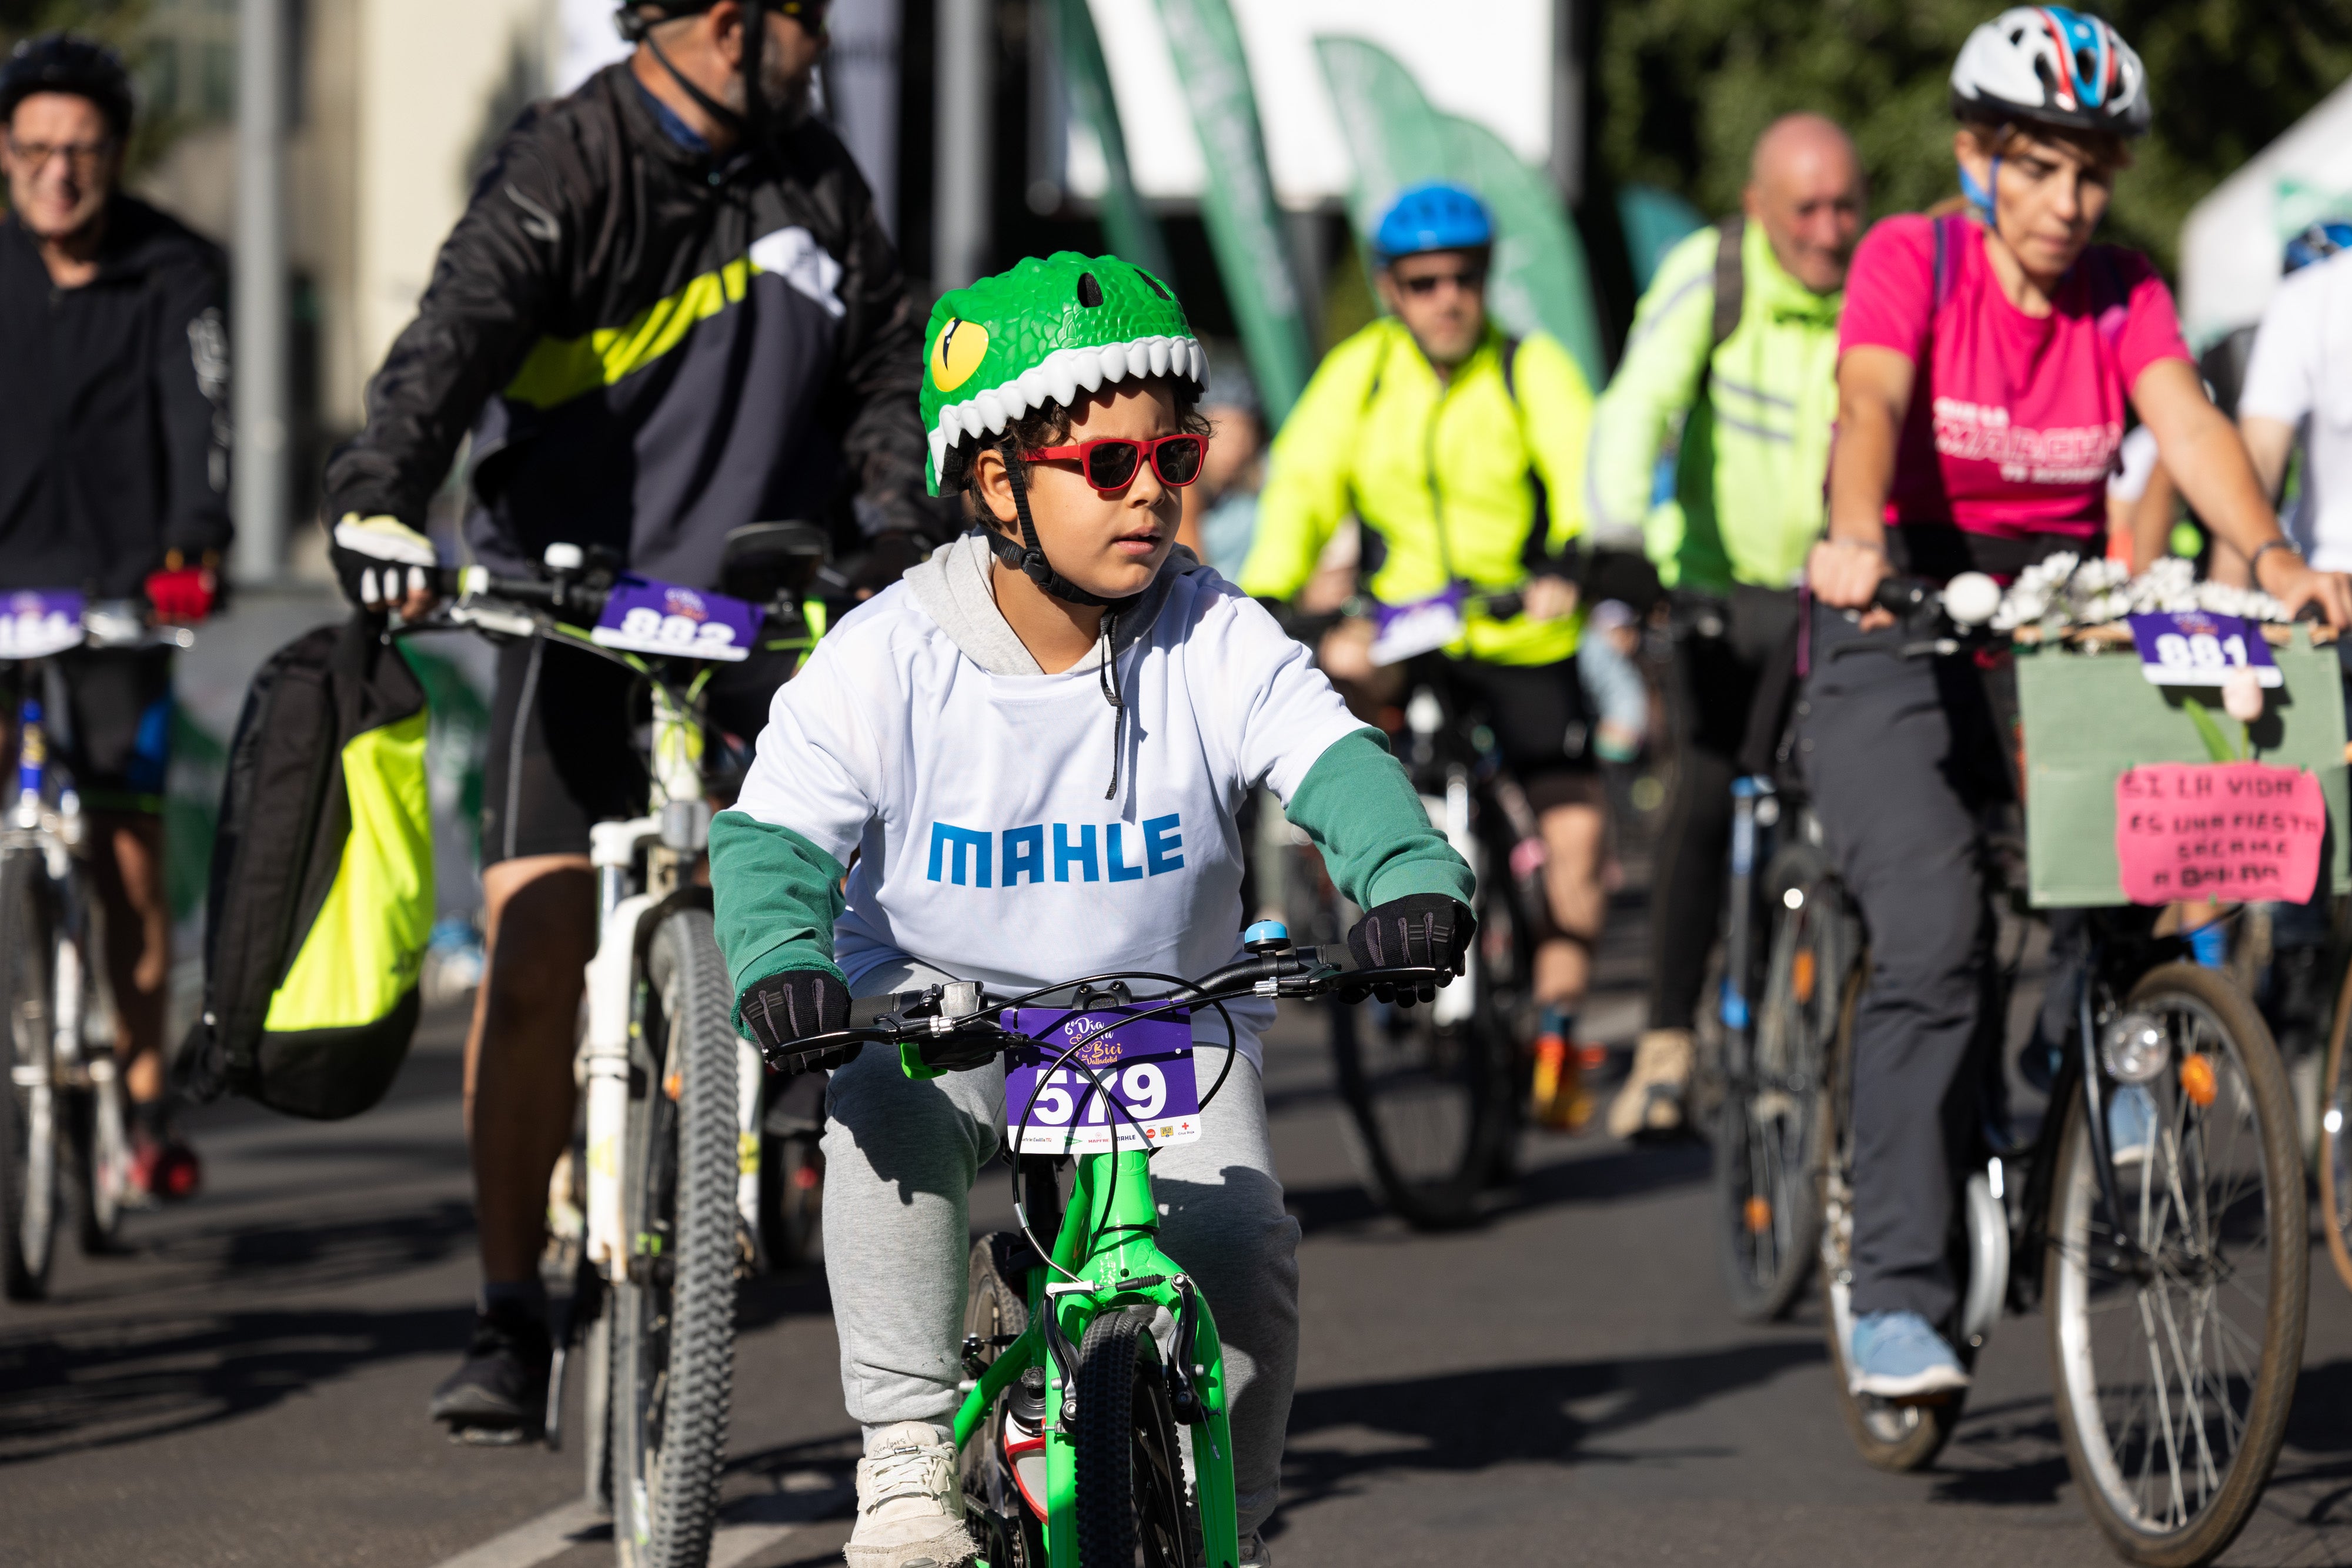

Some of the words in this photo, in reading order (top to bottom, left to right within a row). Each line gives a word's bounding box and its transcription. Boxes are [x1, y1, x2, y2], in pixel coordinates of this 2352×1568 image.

[2155, 633, 2248, 668] 881
[2178, 774, 2213, 797] LA
[2226, 776, 2293, 797] VIDA
[927, 813, 1185, 888] MAHLE
[1075, 1017, 1104, 1034] Día
[1081, 1055, 1117, 1065] Valladolid
[1092, 1041, 1122, 1058] Bici
[1033, 1063, 1167, 1124] 579
